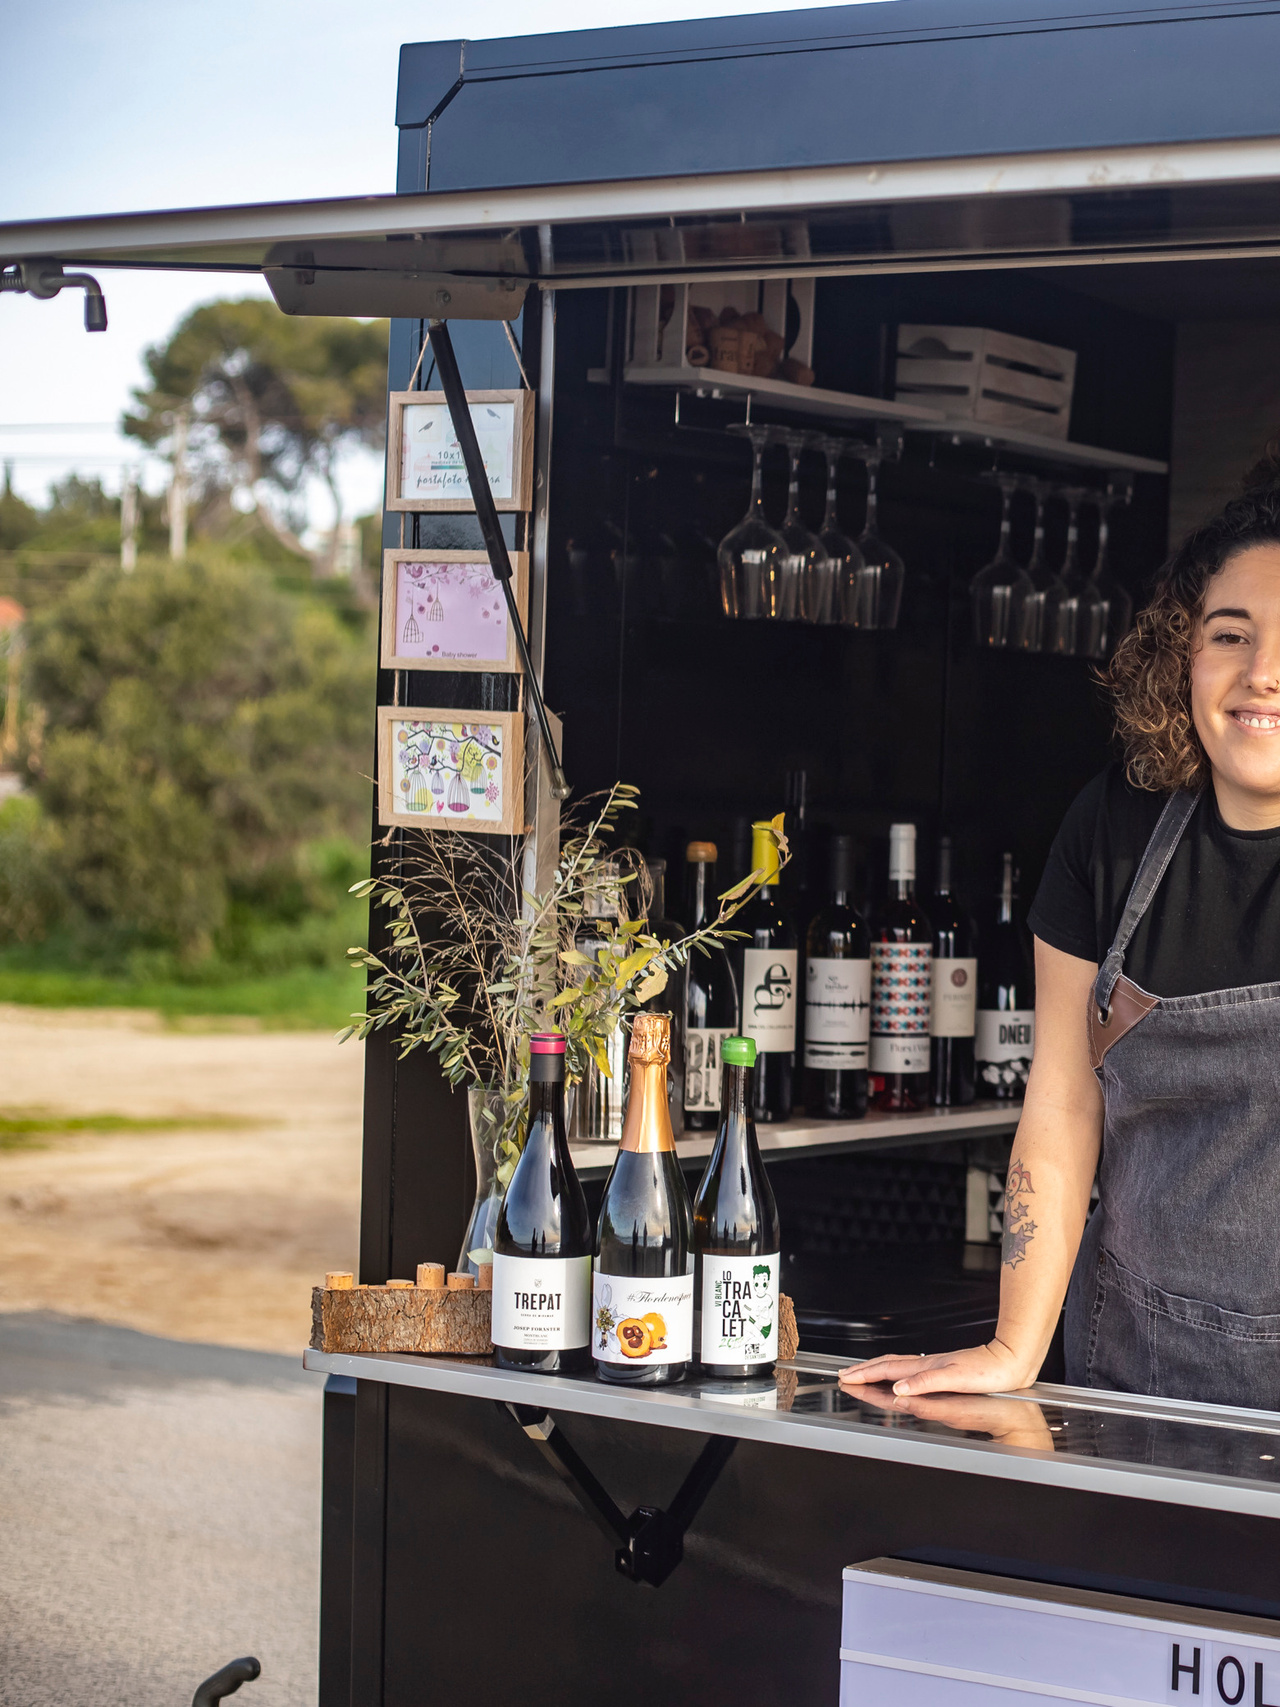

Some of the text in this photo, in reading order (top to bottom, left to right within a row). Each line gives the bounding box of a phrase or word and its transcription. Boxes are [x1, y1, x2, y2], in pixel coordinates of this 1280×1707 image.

[438, 451, 460, 459] 10x1
[417, 472, 462, 488] portafoto
[441, 651, 456, 659] Baby
[722, 1270, 732, 1281] LO
[722, 1281, 752, 1300] TRA
[514, 1291, 561, 1310] TREPAT
[722, 1300, 742, 1318] CA
[722, 1318, 747, 1337] LET
